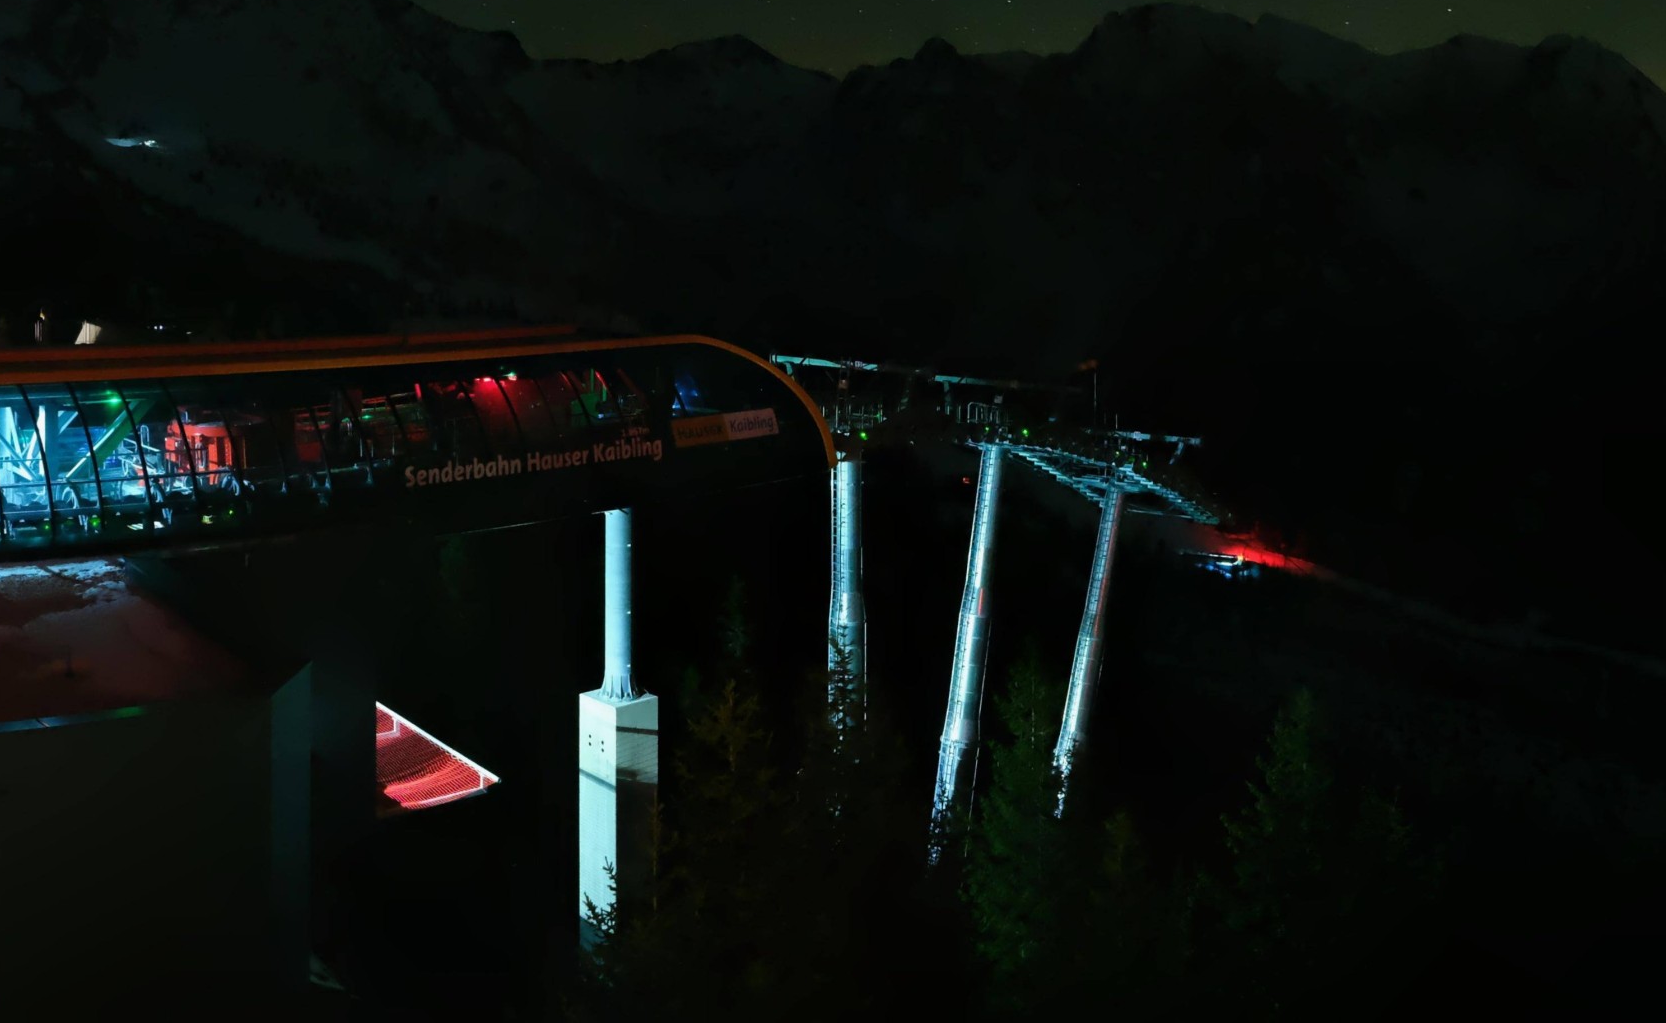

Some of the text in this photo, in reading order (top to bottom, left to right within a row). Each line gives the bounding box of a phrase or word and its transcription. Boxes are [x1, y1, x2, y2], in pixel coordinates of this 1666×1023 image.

[730, 416, 774, 433] Kaibling
[405, 437, 663, 488] Senderbahn Hauser Kaibling
